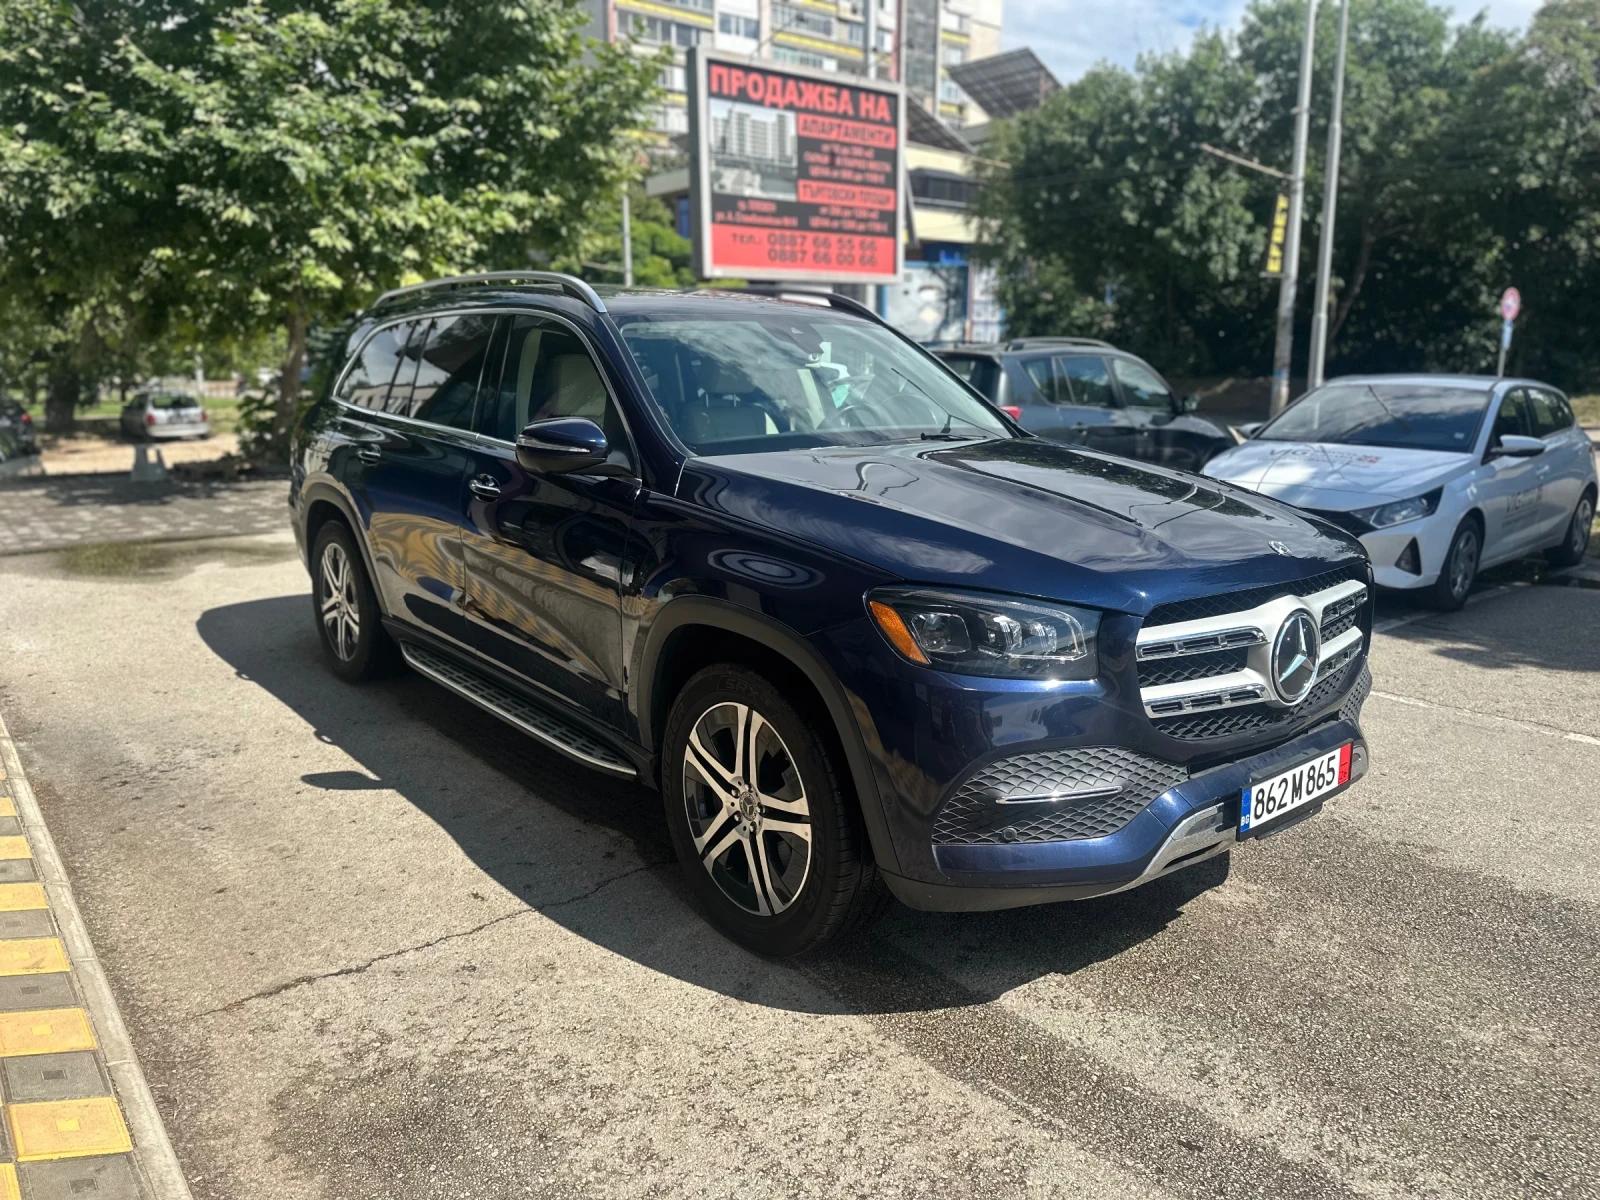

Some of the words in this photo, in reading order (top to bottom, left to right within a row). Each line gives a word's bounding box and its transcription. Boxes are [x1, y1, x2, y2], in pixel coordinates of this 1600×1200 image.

[709, 64, 855, 117] ПРОДАЖБА
[858, 91, 892, 123] НА
[801, 117, 892, 145] АПАРТАМЕНТИ
[767, 232, 807, 247] 0887
[812, 235, 832, 249] 66
[859, 239, 877, 252] 66
[767, 248, 807, 263] 0887
[812, 250, 832, 264] 66
[859, 253, 877, 267] 66
[1240, 814, 1250, 827] BG
